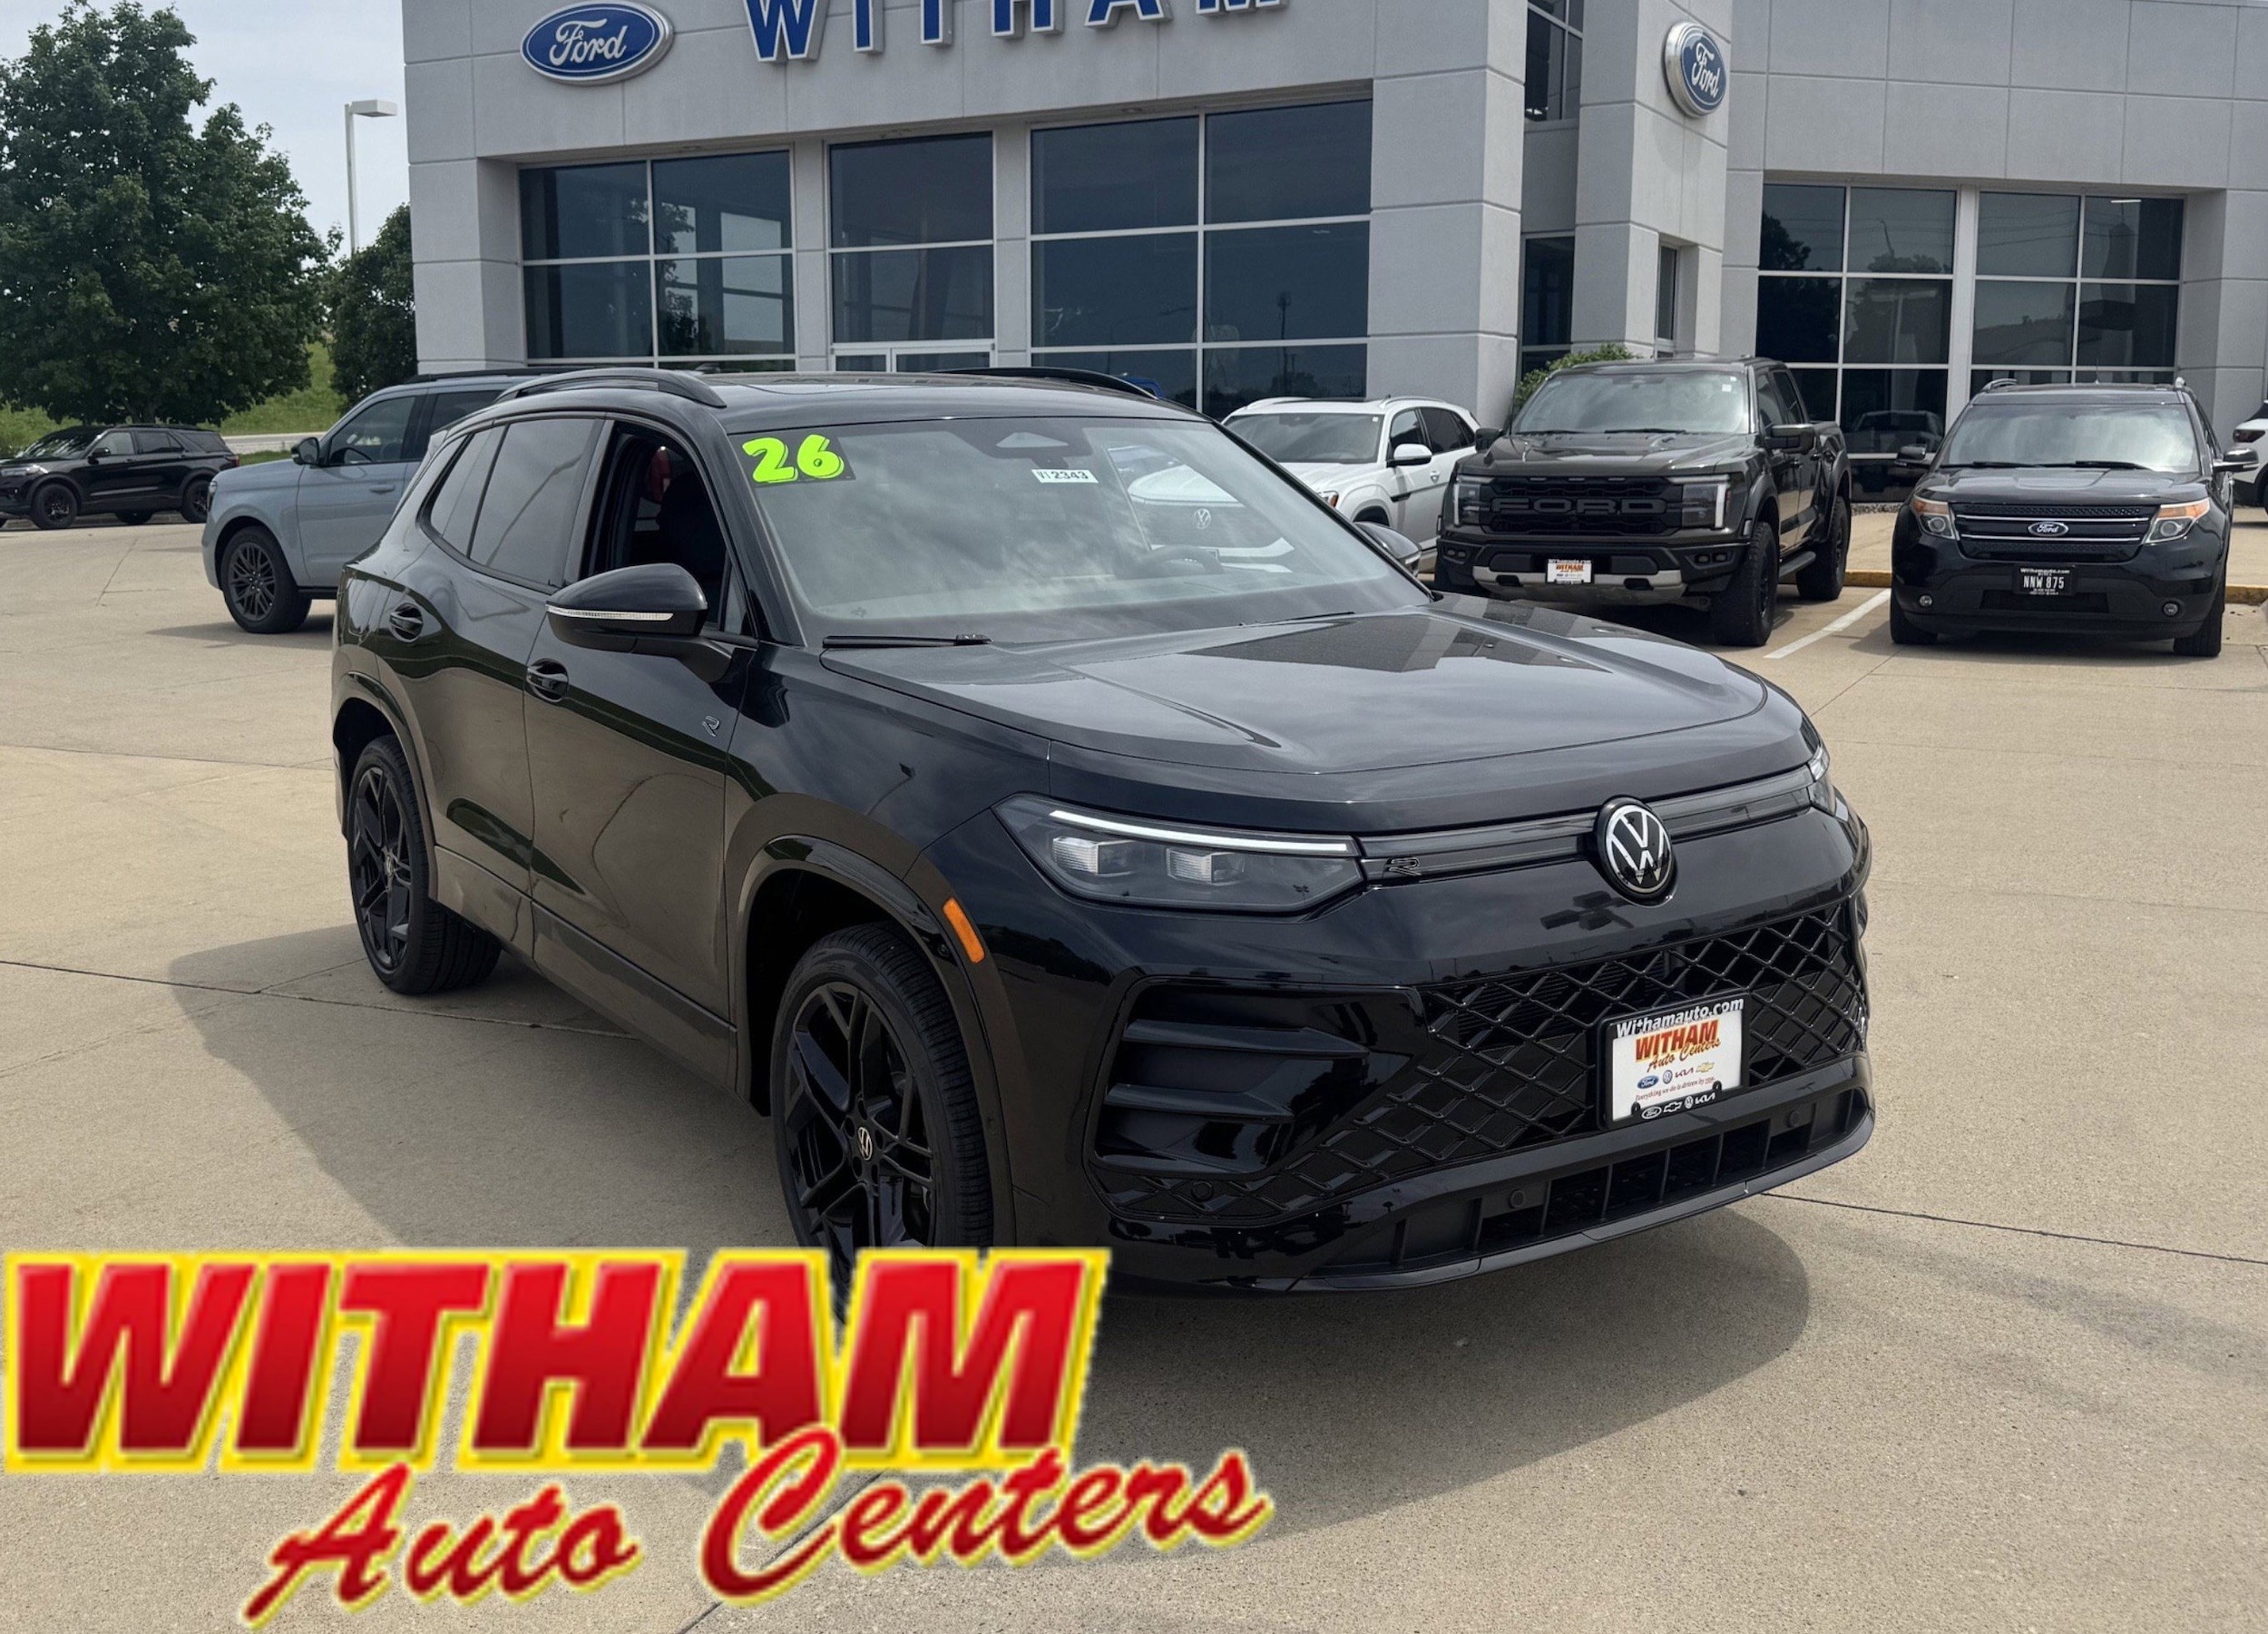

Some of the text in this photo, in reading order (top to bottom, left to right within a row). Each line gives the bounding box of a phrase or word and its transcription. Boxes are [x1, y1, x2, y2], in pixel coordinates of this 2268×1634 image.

[549, 18, 628, 66] Ford
[743, 0, 1280, 62] WIT
[1691, 43, 1720, 98] Ford
[742, 434, 845, 484] 26
[1491, 497, 1667, 515] FORD
[2024, 575, 2064, 589] NNW 875
[1616, 999, 1745, 1039] Withamauto.com
[1636, 1020, 1719, 1061] WITHAM
[1647, 1037, 1722, 1072] Auto Centers
